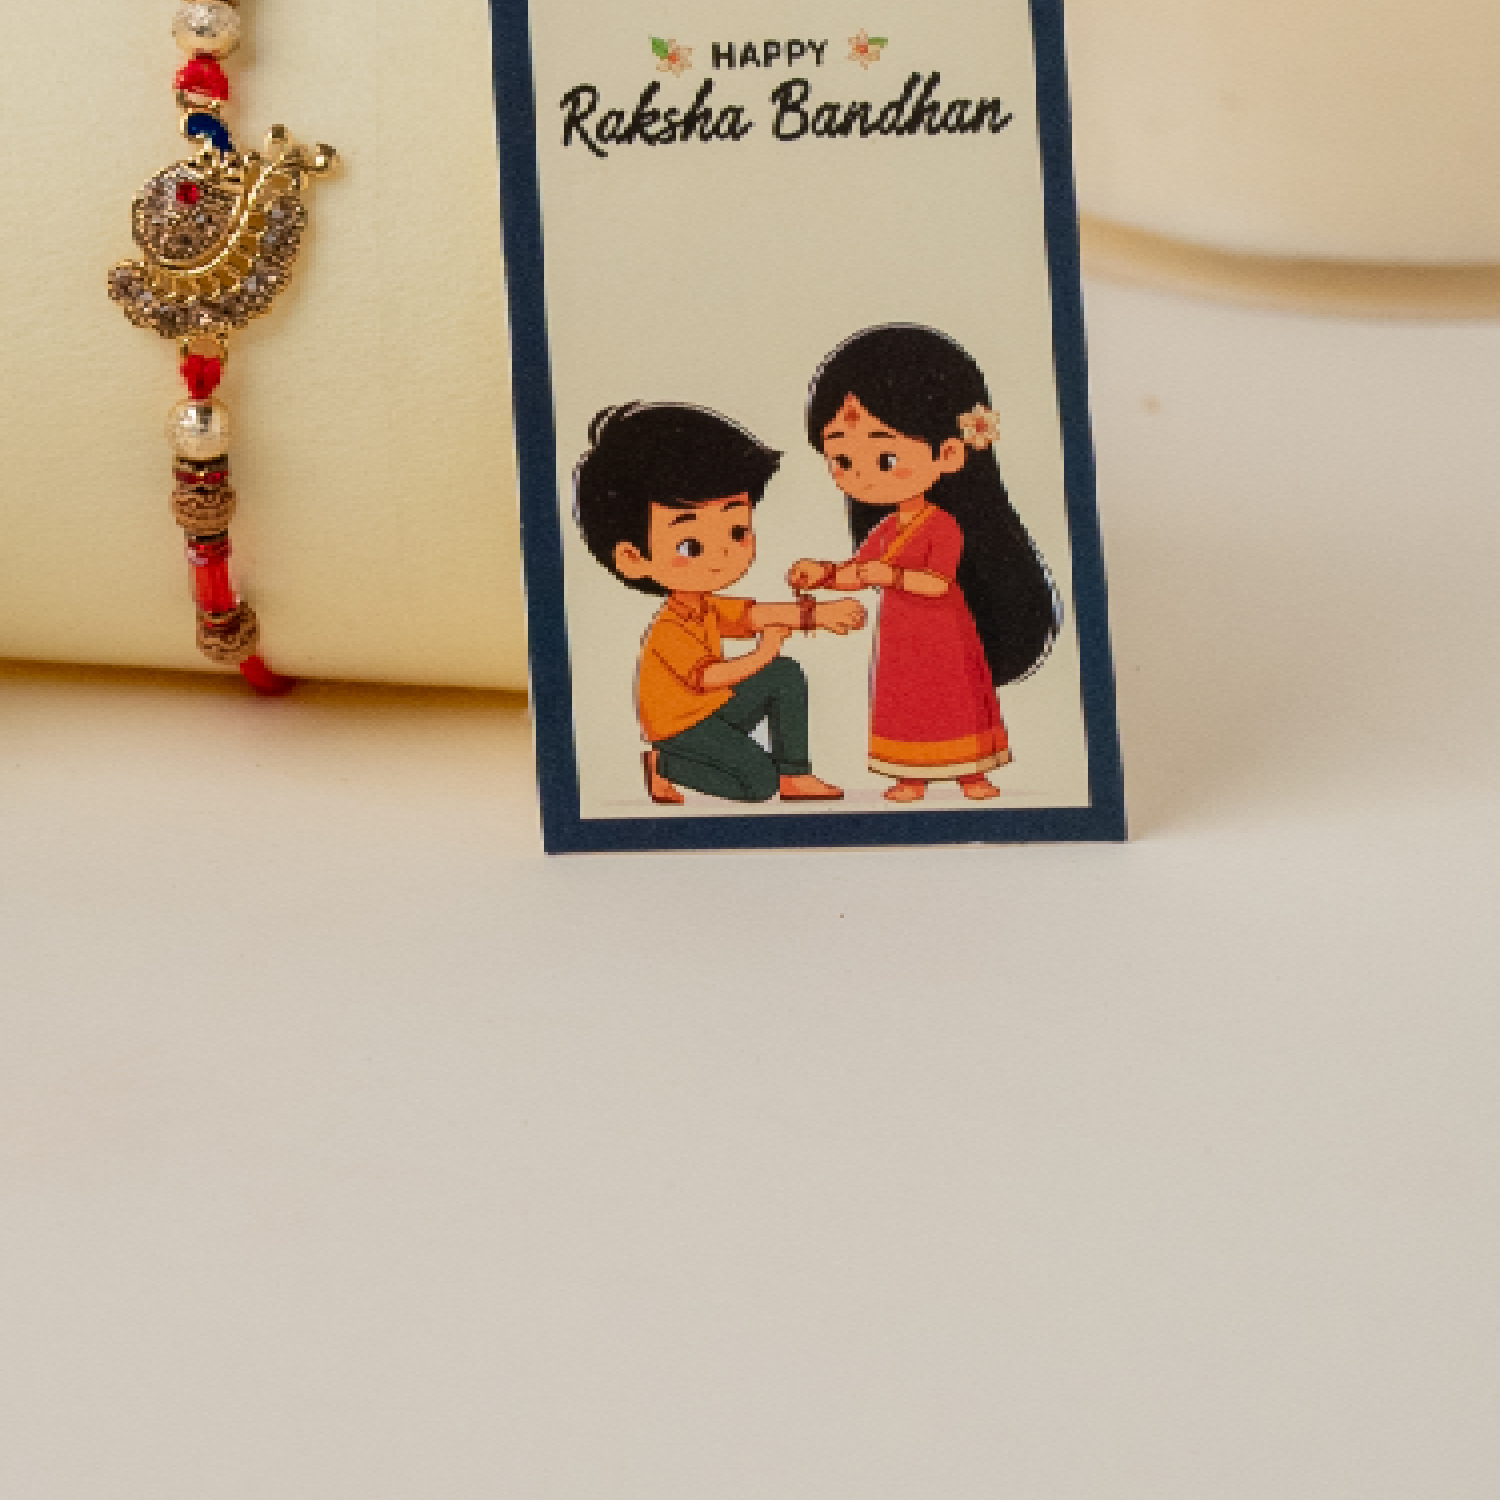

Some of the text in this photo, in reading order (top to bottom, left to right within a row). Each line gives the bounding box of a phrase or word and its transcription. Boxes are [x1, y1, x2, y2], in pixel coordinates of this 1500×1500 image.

[710, 38, 829, 70] HAPPY
[559, 71, 1013, 158] Raksha Bandhan
